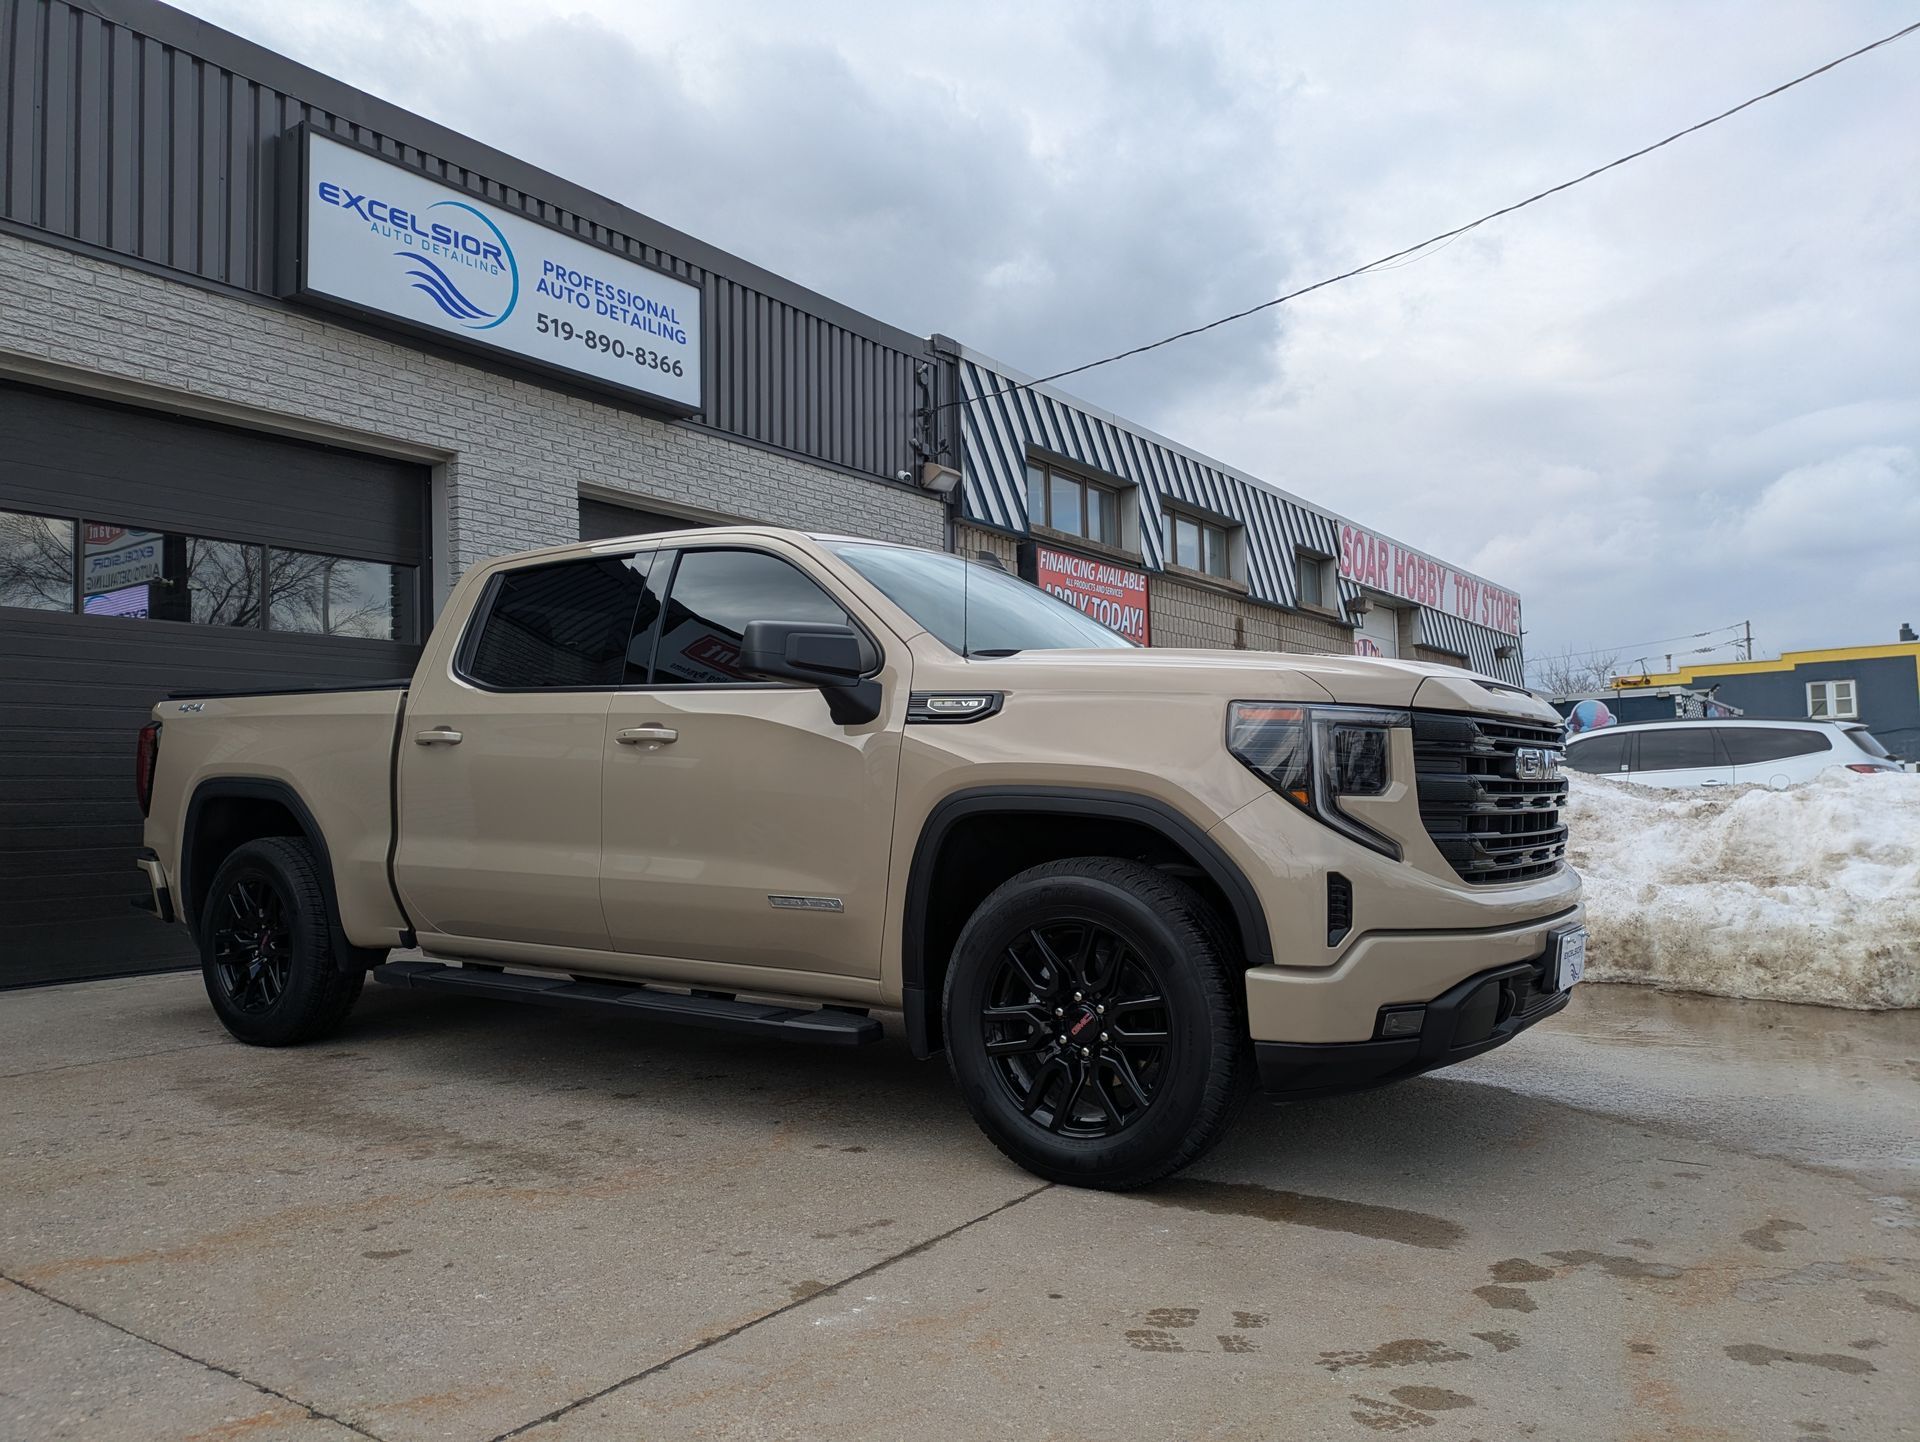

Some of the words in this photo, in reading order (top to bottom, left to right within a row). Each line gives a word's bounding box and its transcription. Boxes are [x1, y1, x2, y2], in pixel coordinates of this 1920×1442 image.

[318, 181, 506, 271] EXCELSIOR
[370, 222, 413, 246] AUTO
[421, 239, 499, 276] DETAILING
[536, 277, 589, 309] AUTO
[596, 298, 687, 345] DETAILING
[543, 259, 680, 325] PROFESSIONAL
[536, 312, 684, 377] 519-890-8366
[1040, 550, 1096, 580] FINANCING
[1096, 565, 1145, 592] AVAILABLE
[1065, 577, 1074, 586] ALL
[1074, 579, 1096, 592] PRODUCTS
[1096, 584, 1105, 593] AND
[1104, 586, 1123, 598] SERVICES
[1340, 525, 1389, 591] SOAR
[1394, 549, 1448, 610] HOBBY
[1453, 573, 1479, 622] TOY
[1482, 584, 1518, 635] STORE
[1091, 597, 1144, 637] TODAY!
